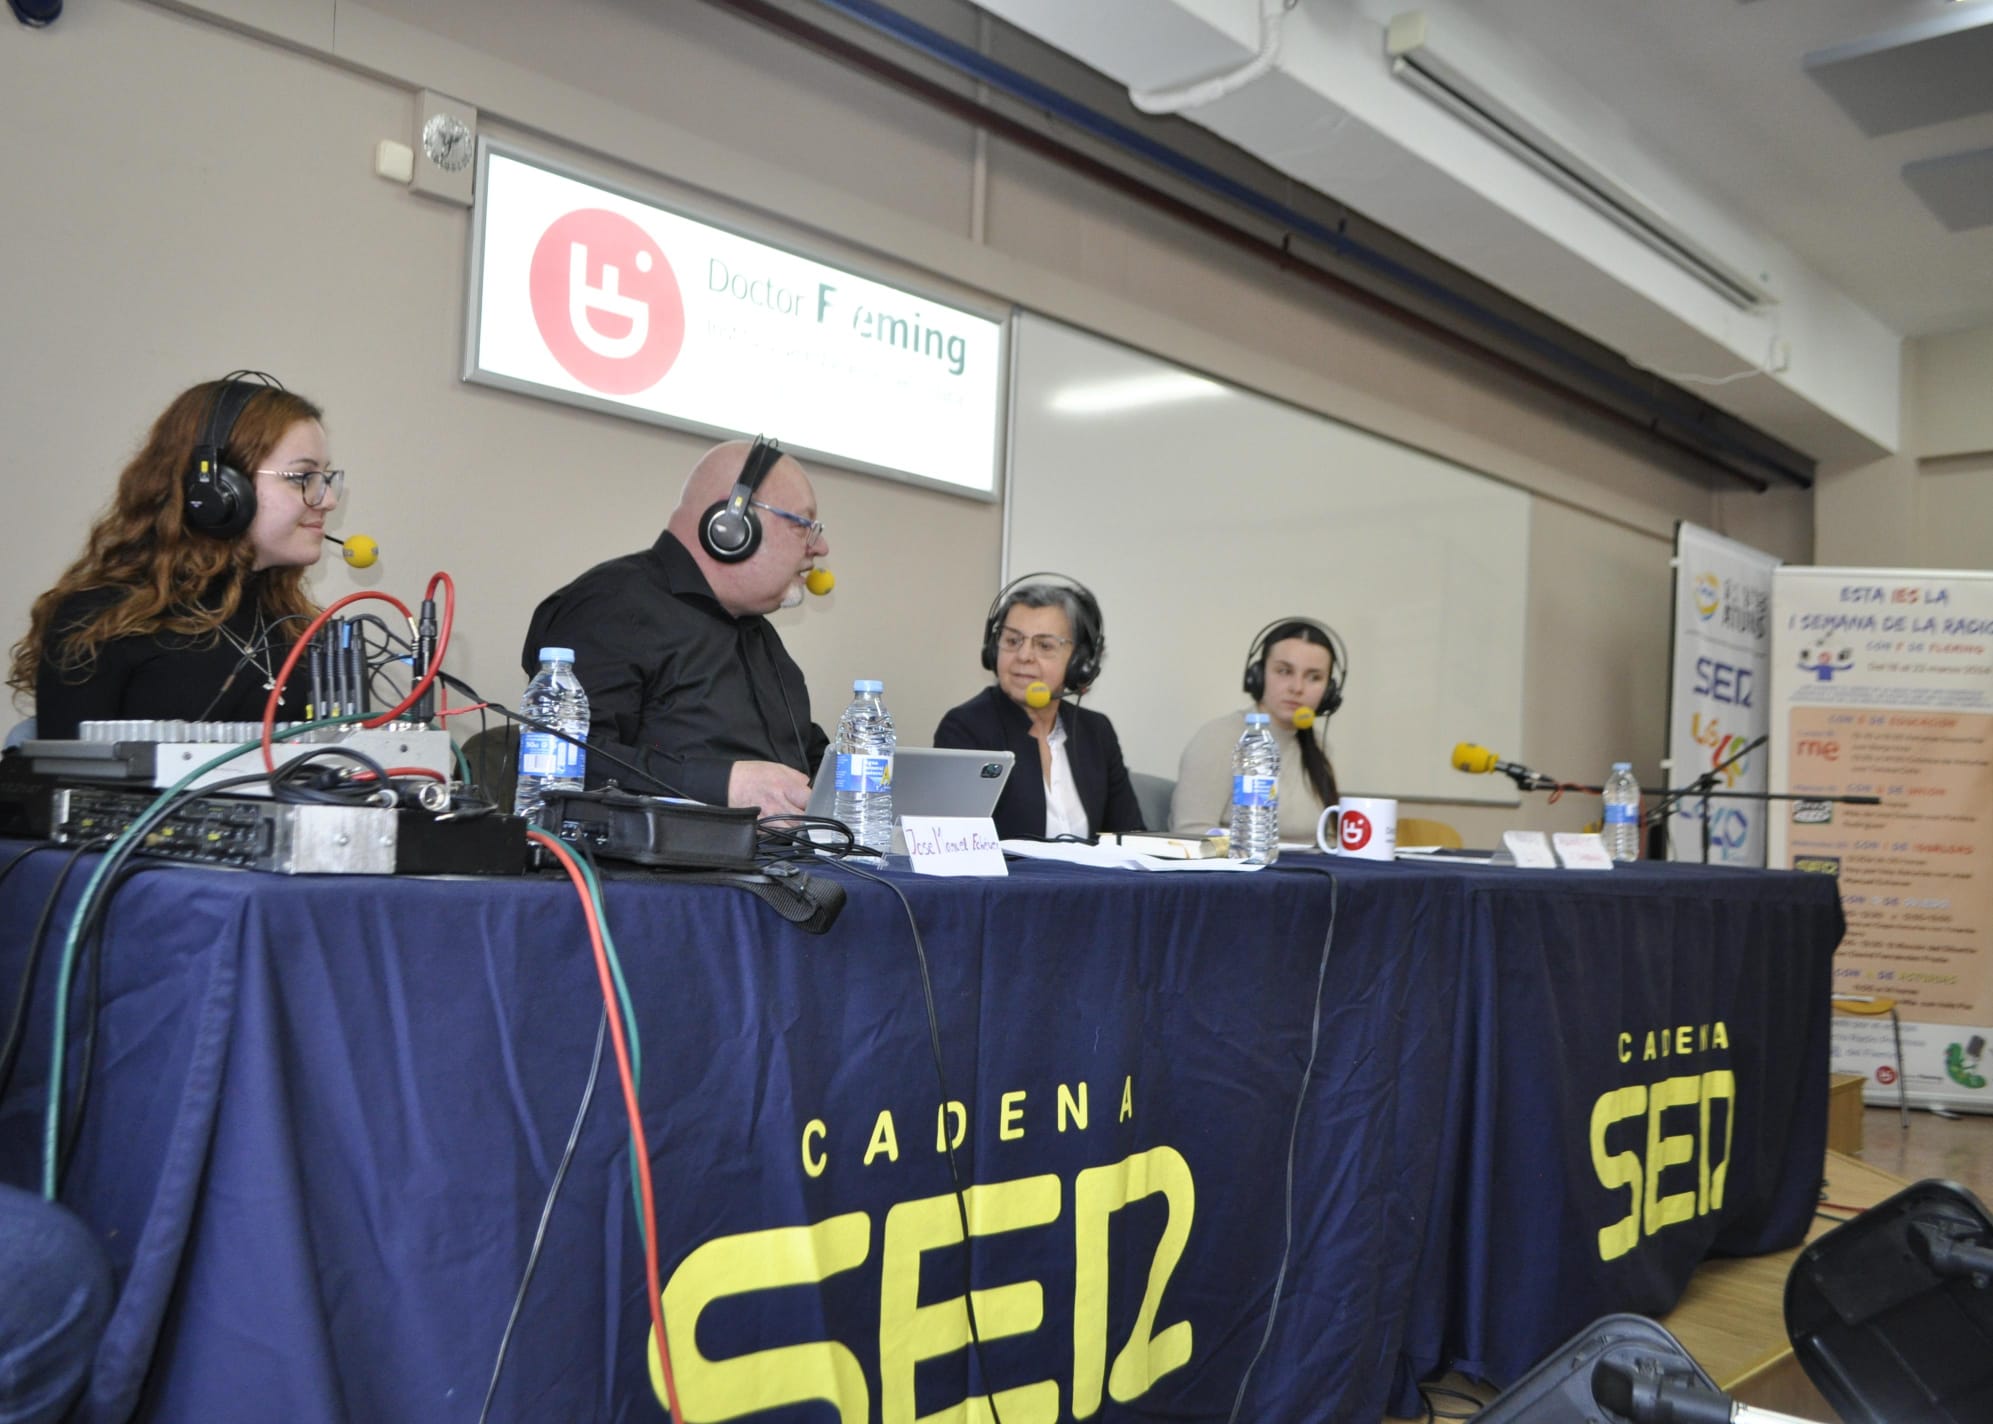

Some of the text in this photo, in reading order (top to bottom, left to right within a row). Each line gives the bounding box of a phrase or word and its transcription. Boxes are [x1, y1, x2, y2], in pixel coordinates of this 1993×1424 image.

[708, 257, 804, 318] Doctor
[816, 281, 967, 375] Feming
[1840, 586, 1948, 604] ESTA IES LA
[1801, 613, 1877, 631] SEMANA
[1882, 615, 1906, 632] DE
[1912, 616, 1936, 632] LA
[1617, 1020, 1729, 1064] CADENA
[801, 1074, 1133, 1177] CADENA
